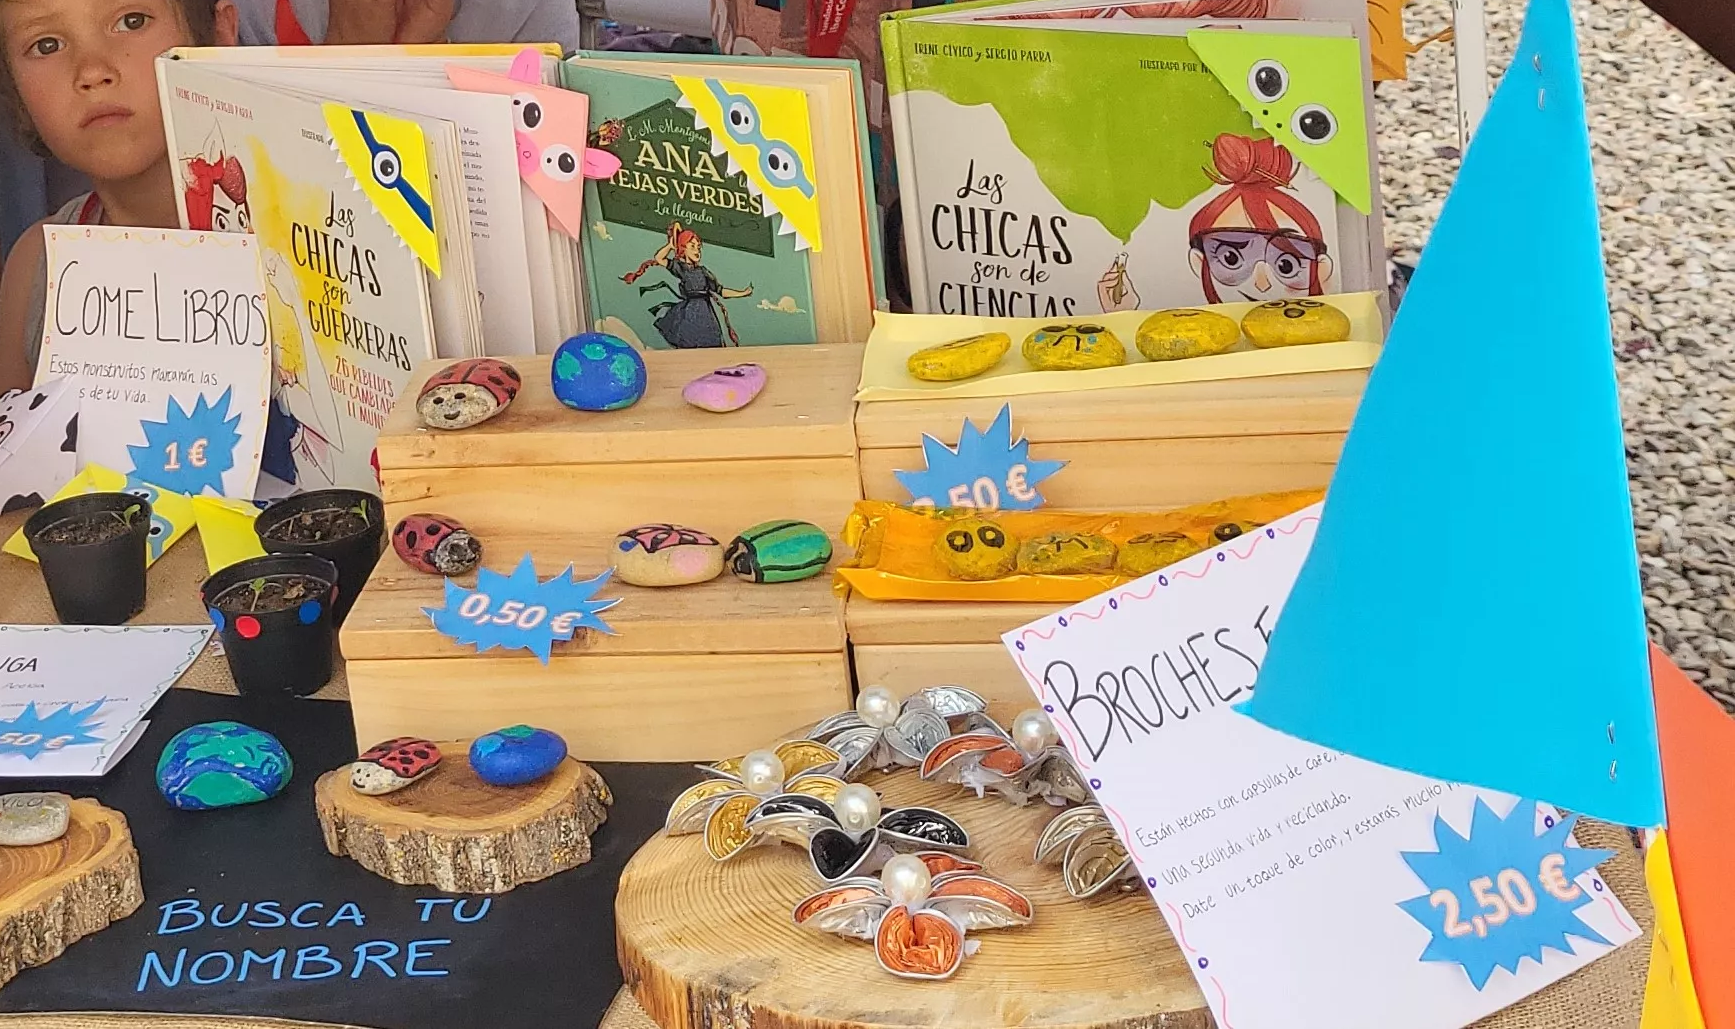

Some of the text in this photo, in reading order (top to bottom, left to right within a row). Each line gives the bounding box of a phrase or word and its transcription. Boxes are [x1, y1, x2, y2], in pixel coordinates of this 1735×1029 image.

[914, 42, 939, 55] IRENE
[974, 51, 983, 62] y
[985, 47, 1018, 61] SERGIO
[1020, 49, 1052, 63] PARRA
[1182, 62, 1197, 72] POR
[634, 139, 725, 183] ANA
[608, 169, 763, 215] TEJAS VERDES
[956, 158, 1009, 205] Las
[325, 191, 356, 237] Las
[654, 198, 714, 225] La llegada
[930, 202, 1073, 266] CHICAS
[290, 221, 383, 298] CHICAS
[970, 258, 1051, 285] son de
[55, 260, 146, 340] COME
[322, 280, 353, 306] son
[938, 281, 1077, 318] CIENCIAS
[308, 299, 412, 372] GUERRERAS
[50, 354, 79, 374] Estos
[200, 370, 218, 386] las
[329, 374, 346, 395] QUE
[335, 355, 350, 377] 26
[89, 385, 104, 401] de
[106, 387, 119, 401] tu
[163, 437, 209, 472] 1 €
[1006, 464, 1036, 502] €
[459, 593, 582, 633] 0,50 €
[1043, 624, 1260, 762] BROCHES
[44, 735, 74, 749] €
[1135, 821, 1176, 848] Están
[1218, 794, 1240, 811] con
[1287, 764, 1303, 779] de
[1182, 895, 1217, 921] Date
[1224, 880, 1247, 901] un
[1287, 850, 1304, 870] de
[1308, 832, 1346, 861] color,
[1354, 803, 1402, 838] estarás
[1429, 852, 1584, 941] 2,50 €
[157, 897, 493, 936] BUSCA TU
[136, 939, 453, 992] NOMBRE
